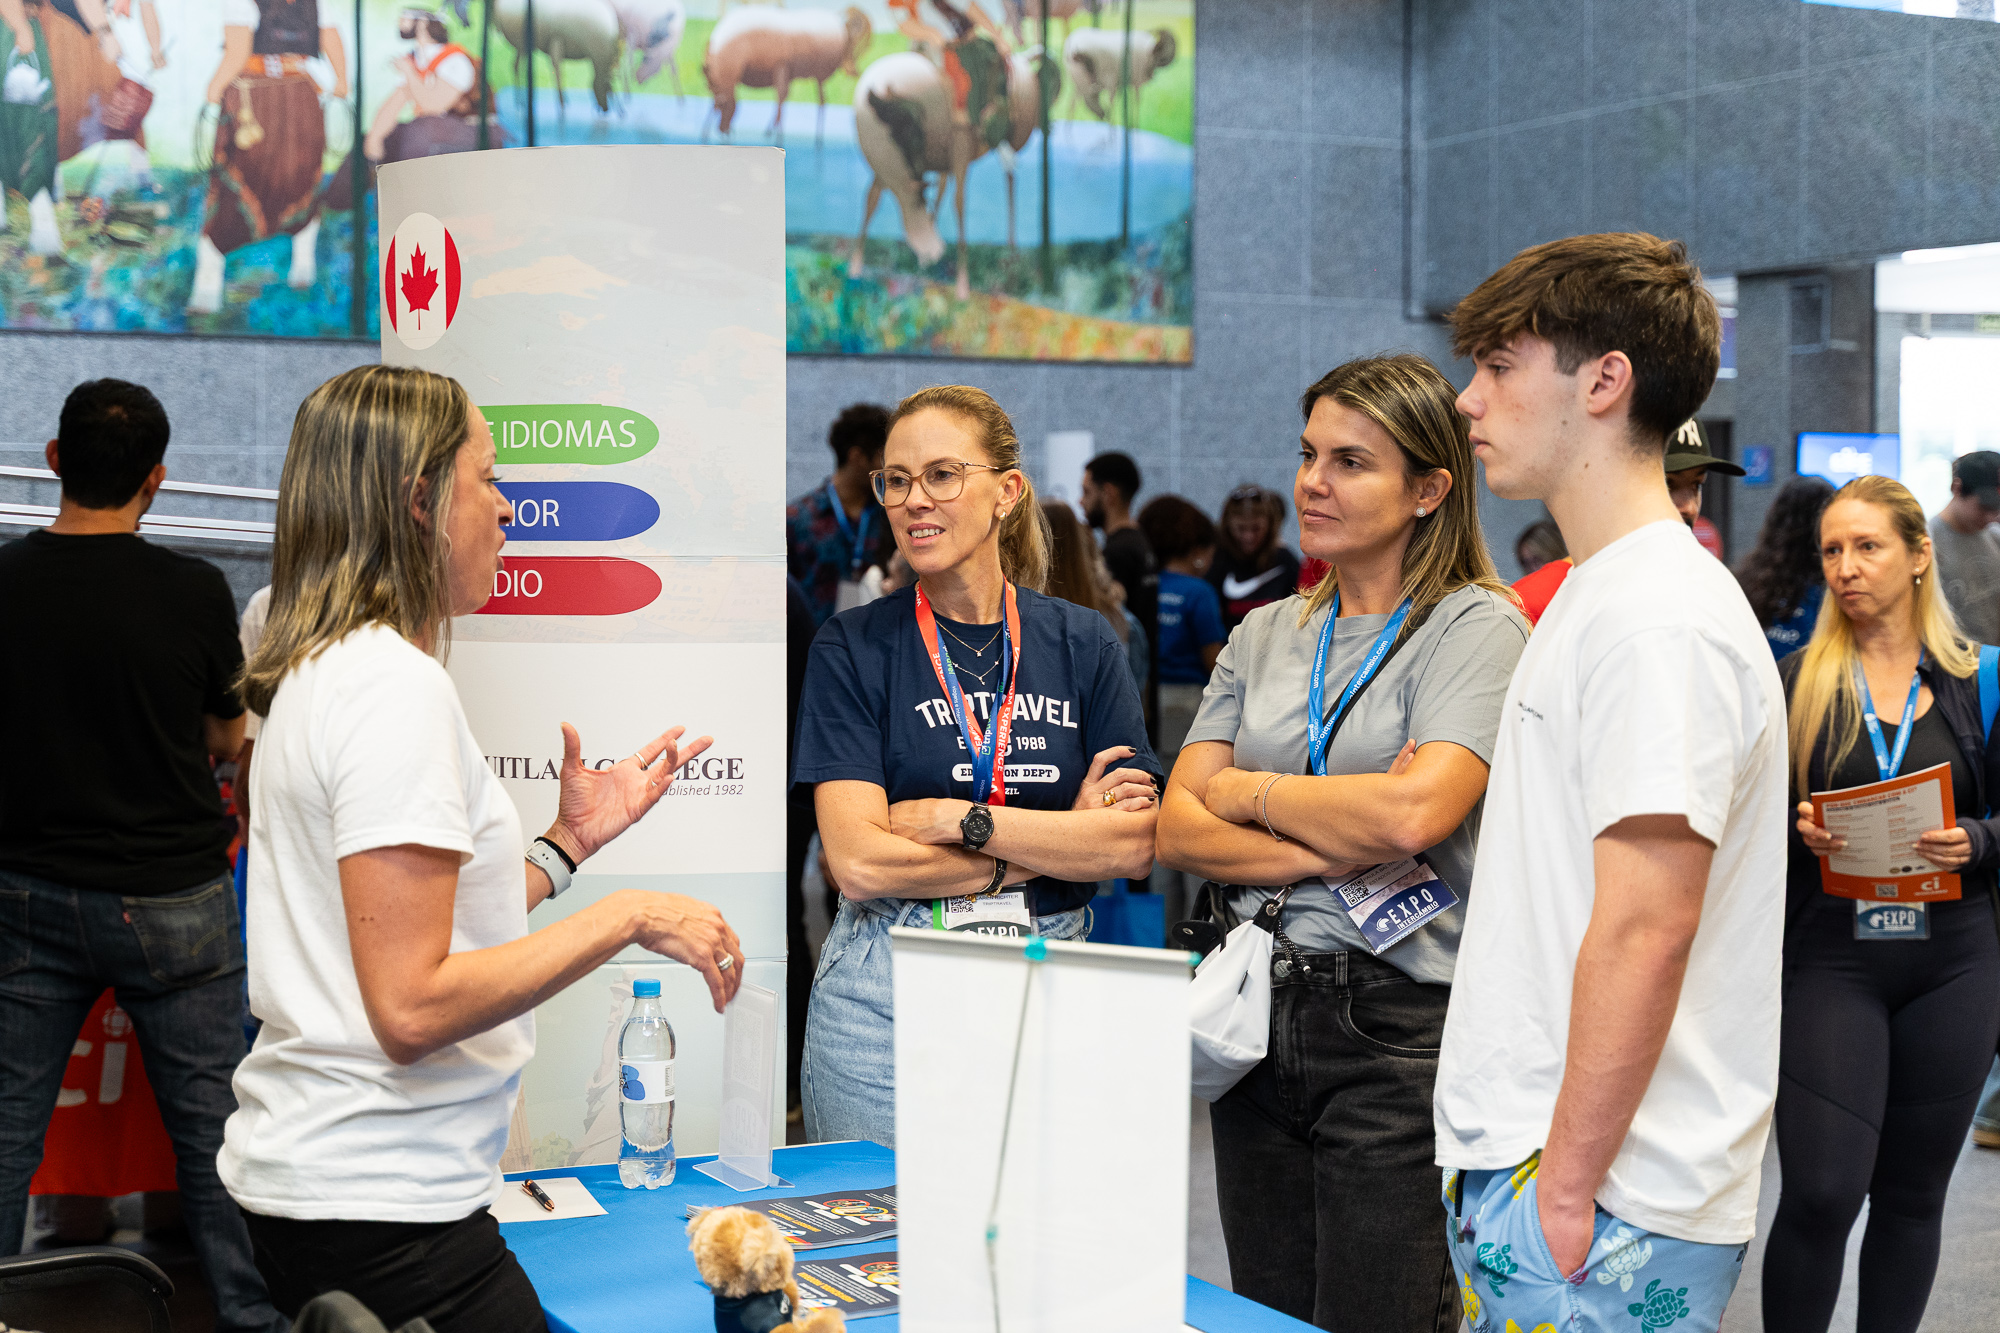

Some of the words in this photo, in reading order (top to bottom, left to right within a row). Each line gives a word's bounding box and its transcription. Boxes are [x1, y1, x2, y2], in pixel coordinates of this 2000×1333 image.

[503, 419, 637, 448] IDIOMAS
[505, 498, 560, 528] IOR
[489, 569, 543, 598] DIO
[997, 707, 1011, 772] EXPERIENCE
[1016, 736, 1047, 750] 1988
[1023, 768, 1053, 778] DEPT
[663, 784, 711, 796] blished
[714, 784, 744, 796] 1982
[1004, 787, 1020, 795] ZIL
[1921, 876, 1940, 891] ci
[1387, 888, 1435, 925] EXPO
[1883, 910, 1916, 925] EXPO
[977, 925, 1019, 939] EXPO
